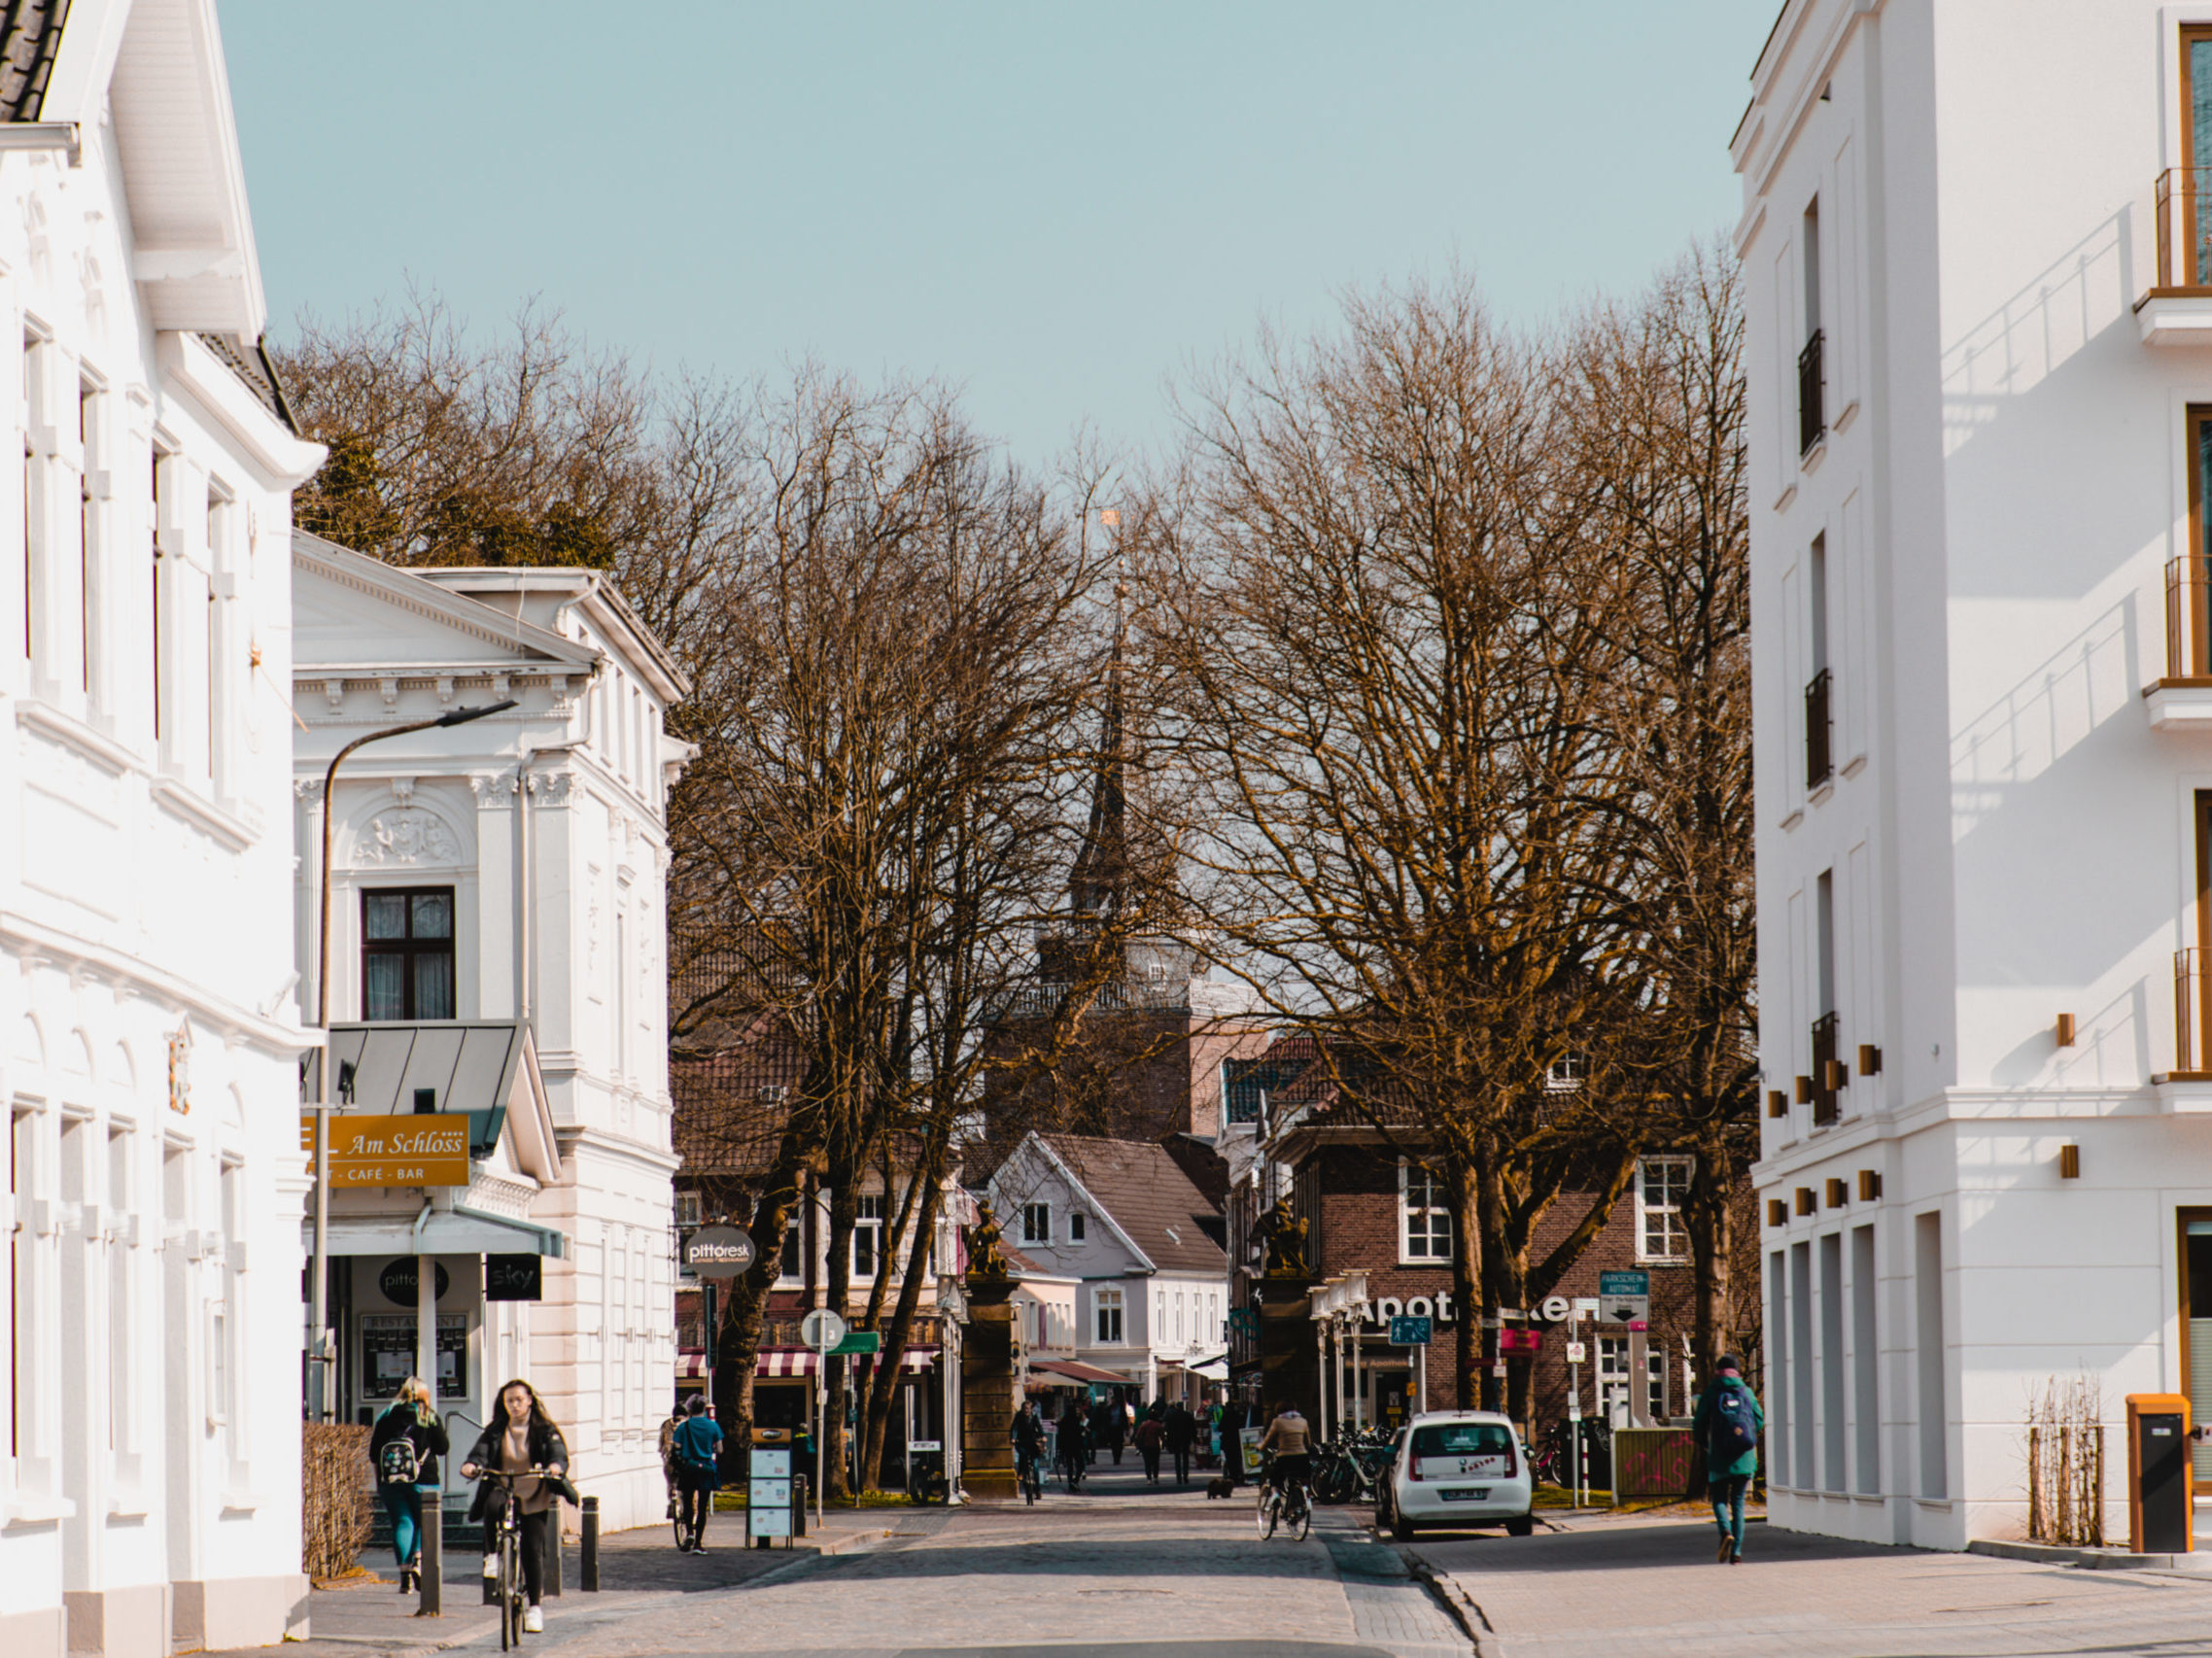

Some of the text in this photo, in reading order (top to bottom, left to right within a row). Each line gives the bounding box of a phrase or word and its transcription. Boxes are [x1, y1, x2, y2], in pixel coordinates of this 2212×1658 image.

[347, 1134, 384, 1155] Am
[389, 1131, 464, 1154] Schloss
[347, 1167, 425, 1180] CAFÉ BAR
[689, 1243, 749, 1263] pittoresk
[492, 1263, 535, 1290] sky
